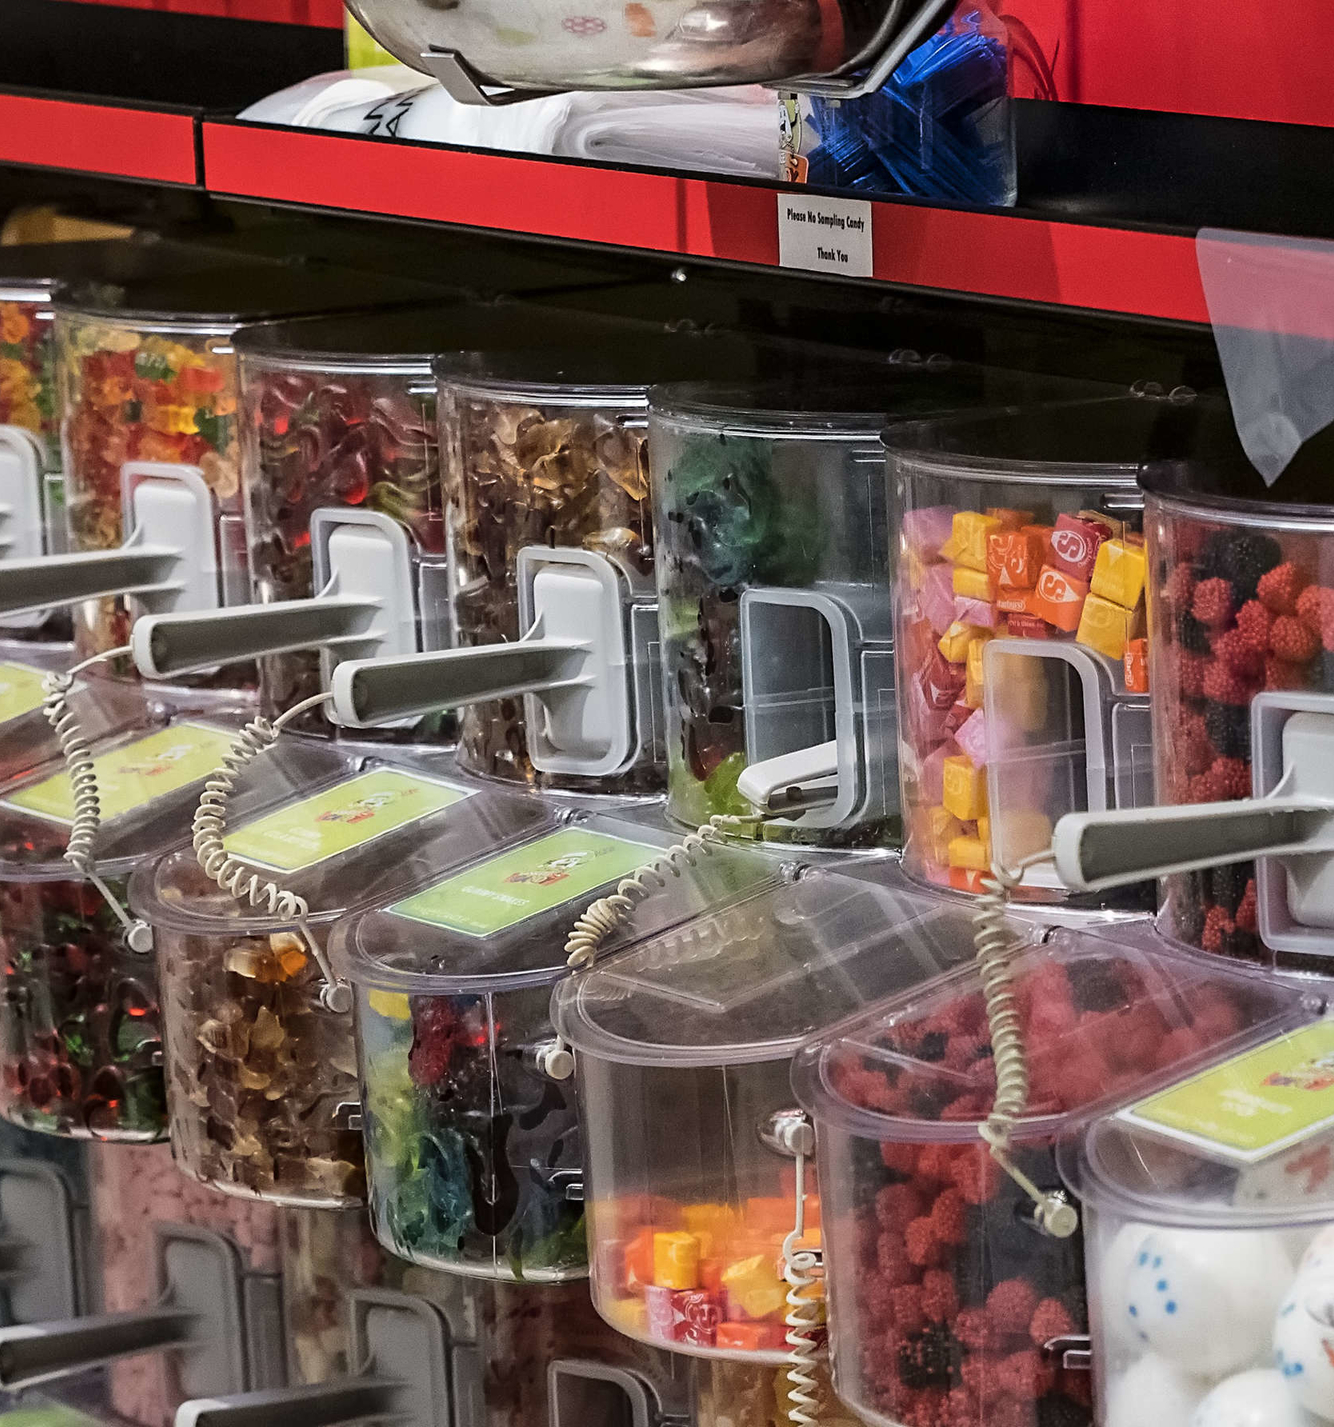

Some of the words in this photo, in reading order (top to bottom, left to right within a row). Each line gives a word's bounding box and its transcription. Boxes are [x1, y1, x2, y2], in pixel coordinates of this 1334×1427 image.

[787, 208, 806, 222] Please
[807, 211, 816, 223] No
[817, 212, 845, 230] Sampling
[846, 216, 865, 233] Candy
[817, 247, 836, 262] Thank
[836, 250, 849, 263] You
